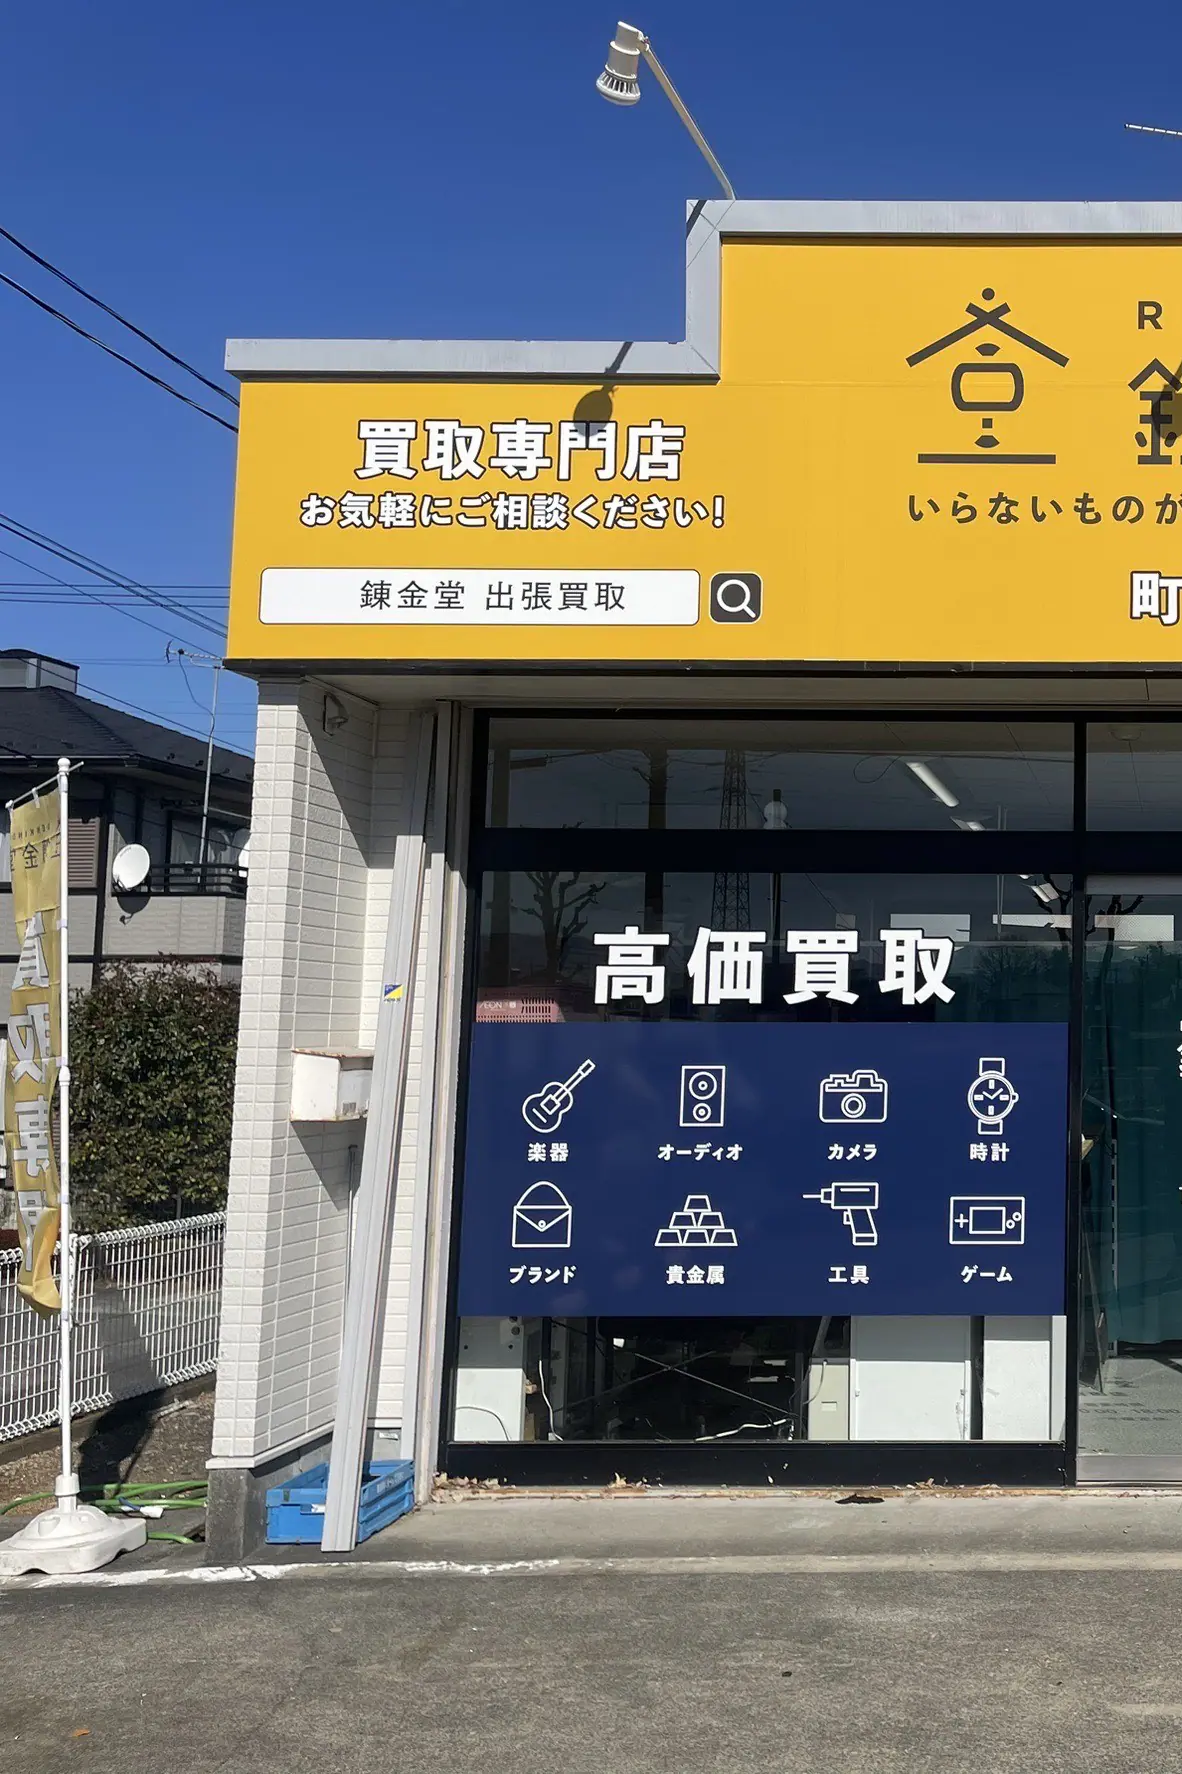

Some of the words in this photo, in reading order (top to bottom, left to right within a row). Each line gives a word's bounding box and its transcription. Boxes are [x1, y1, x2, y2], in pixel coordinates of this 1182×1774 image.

[354, 418, 685, 481] 買取専門店
[300, 491, 724, 530] お気軽にご相談ください!
[360, 580, 464, 610] 錬金堂
[486, 582, 624, 611] 出張買取
[593, 925, 957, 1005] 高価買取
[528, 1143, 568, 1161] 楽器
[658, 1143, 742, 1160] オーディオ
[828, 1144, 877, 1160] カメラ
[970, 1143, 1009, 1161] 時計
[510, 1265, 576, 1283] ブランド
[666, 1265, 724, 1284] 貴金属
[829, 1266, 869, 1284] 工具
[961, 1265, 1012, 1283] ゲーム
